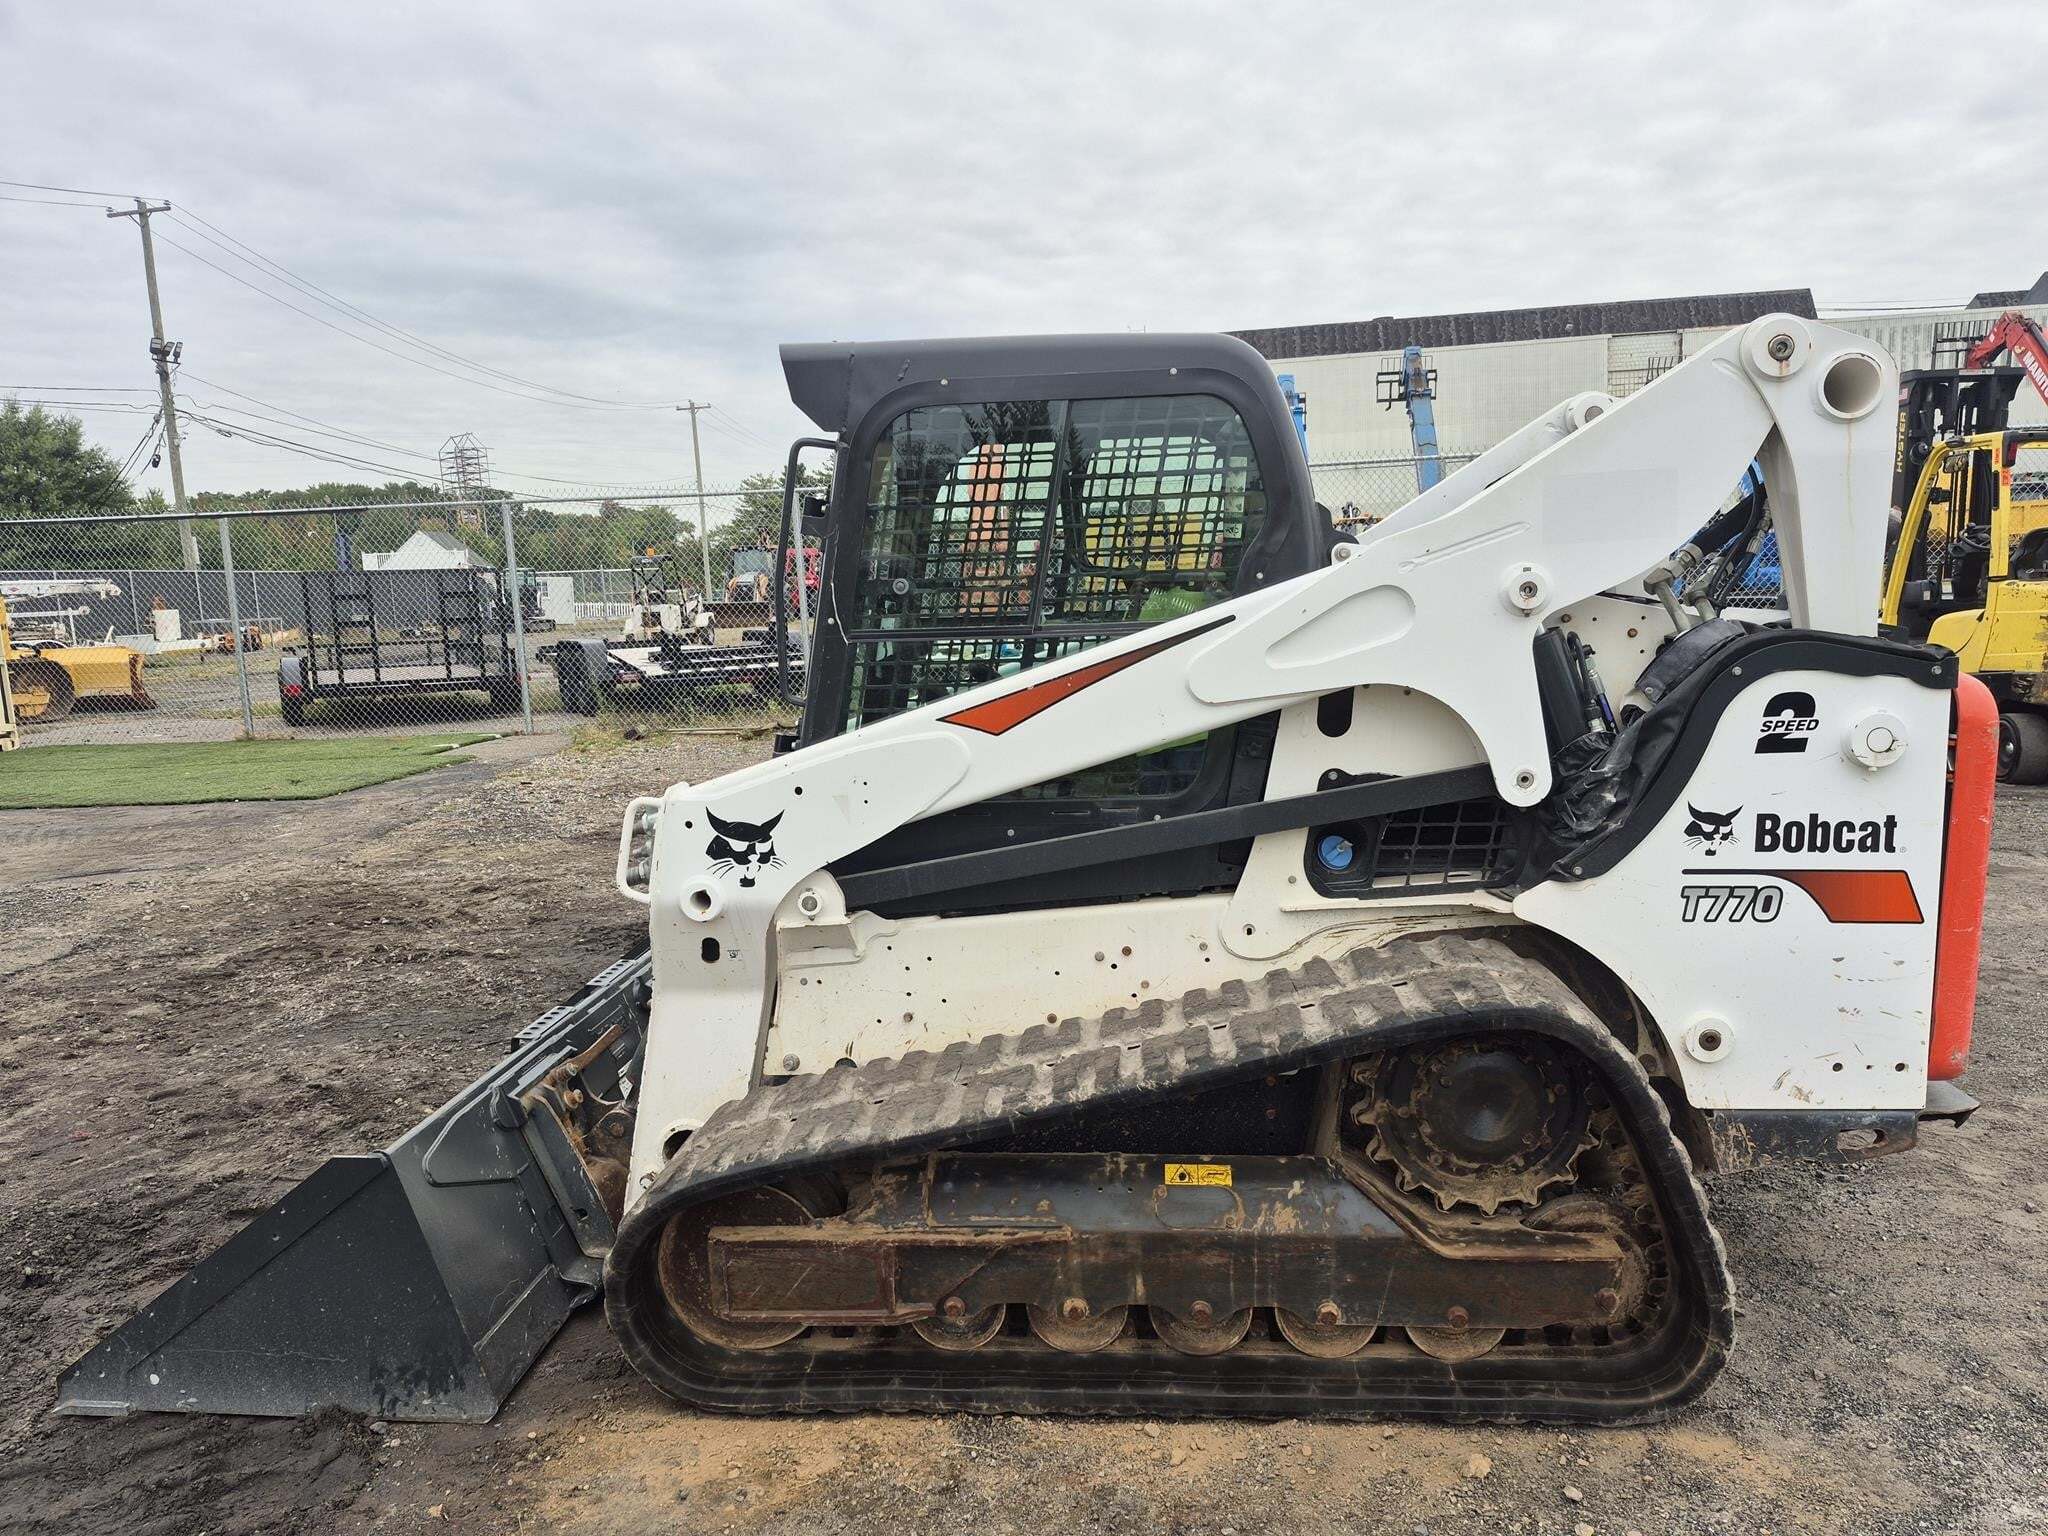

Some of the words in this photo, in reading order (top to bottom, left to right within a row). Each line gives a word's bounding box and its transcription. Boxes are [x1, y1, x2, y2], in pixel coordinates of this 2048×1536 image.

[1896, 411, 1906, 473] HYSTER
[1755, 691, 1816, 754] 2
[1760, 719, 1820, 732] SPEED
[1755, 813, 1898, 854] Bobcat
[1681, 885, 1784, 923] T770
